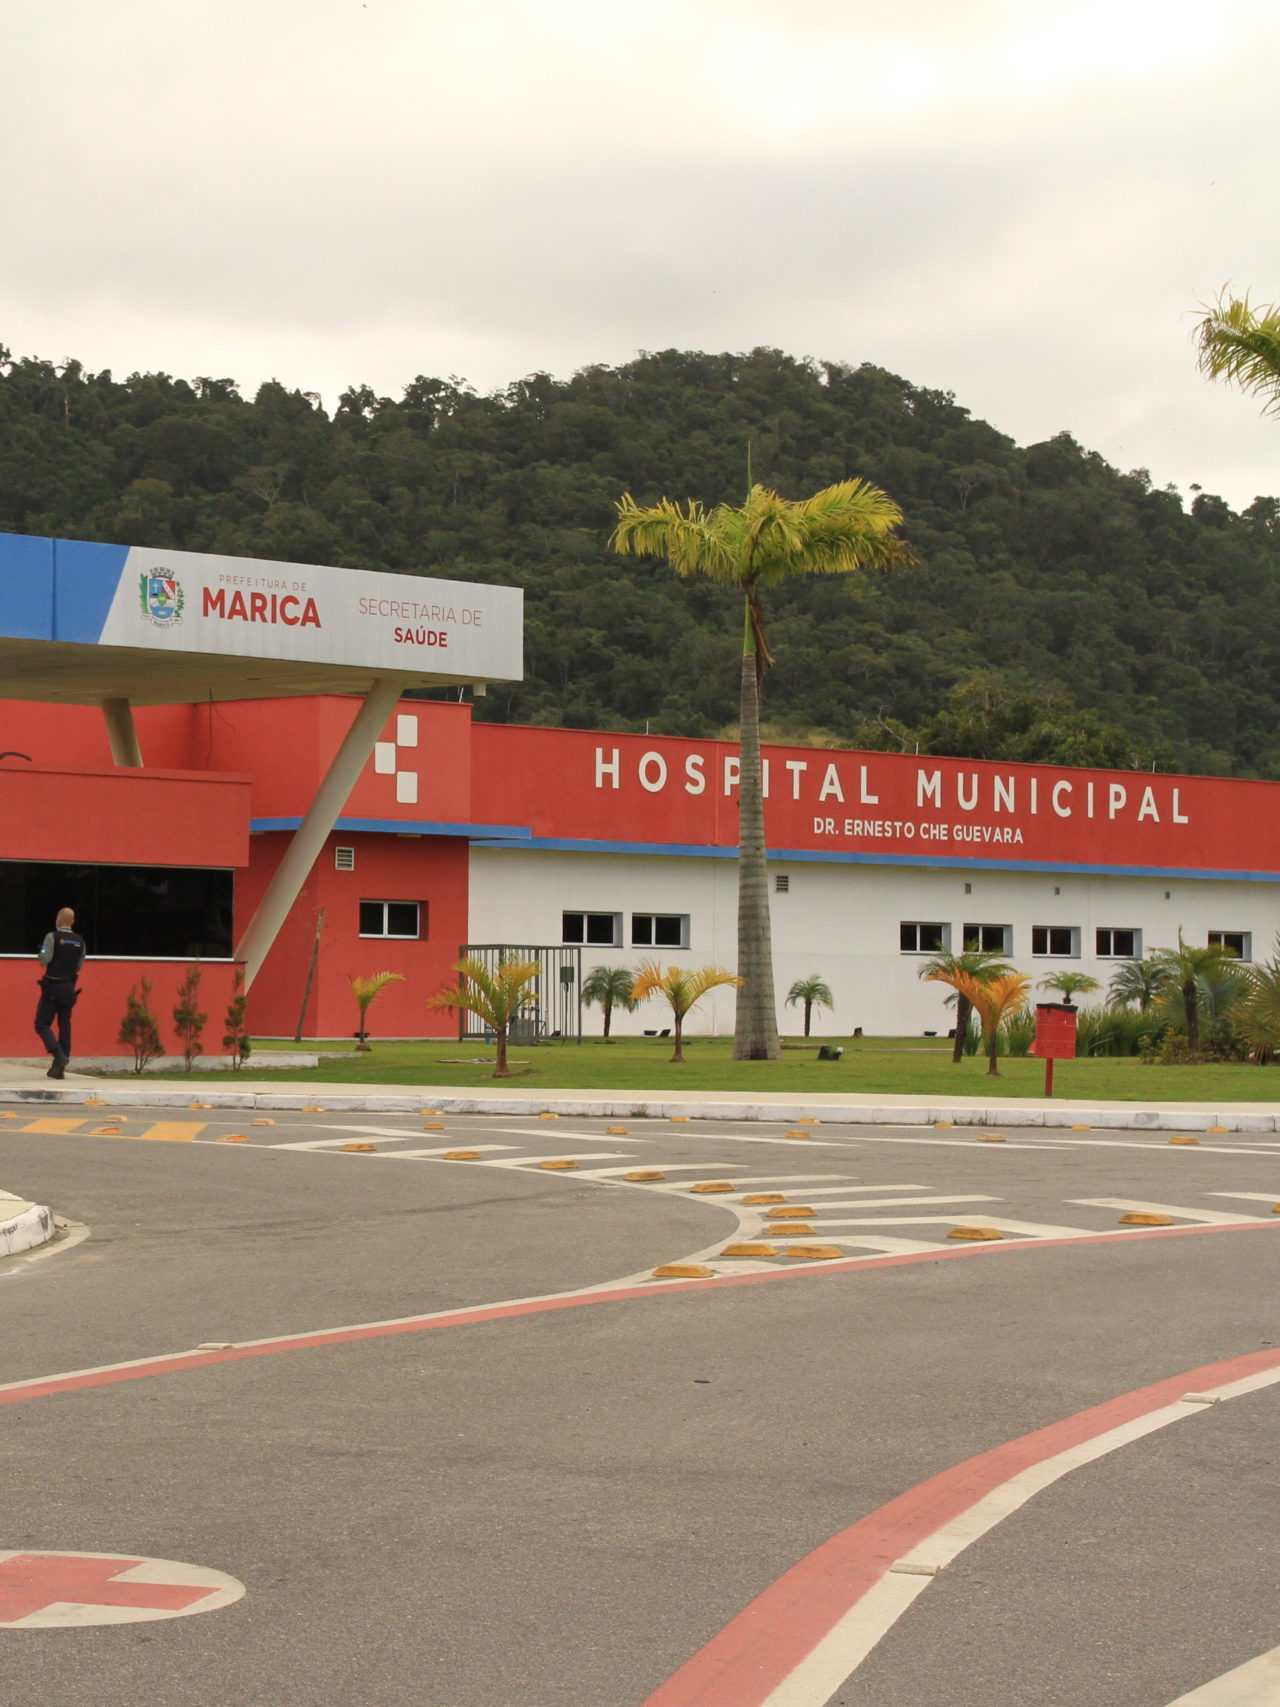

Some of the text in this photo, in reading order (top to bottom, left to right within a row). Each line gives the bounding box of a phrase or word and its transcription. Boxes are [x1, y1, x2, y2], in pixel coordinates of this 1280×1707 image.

[219, 574, 307, 592] PREFEITURA DE
[202, 586, 322, 629] MARICA
[359, 597, 482, 627] SECRETARIA DE
[393, 624, 448, 648] SAÚDE
[595, 747, 1189, 824] HOSPITAL MUNICIPAL
[813, 817, 1024, 844] DR. ERNESTO CHE GUEVARA
